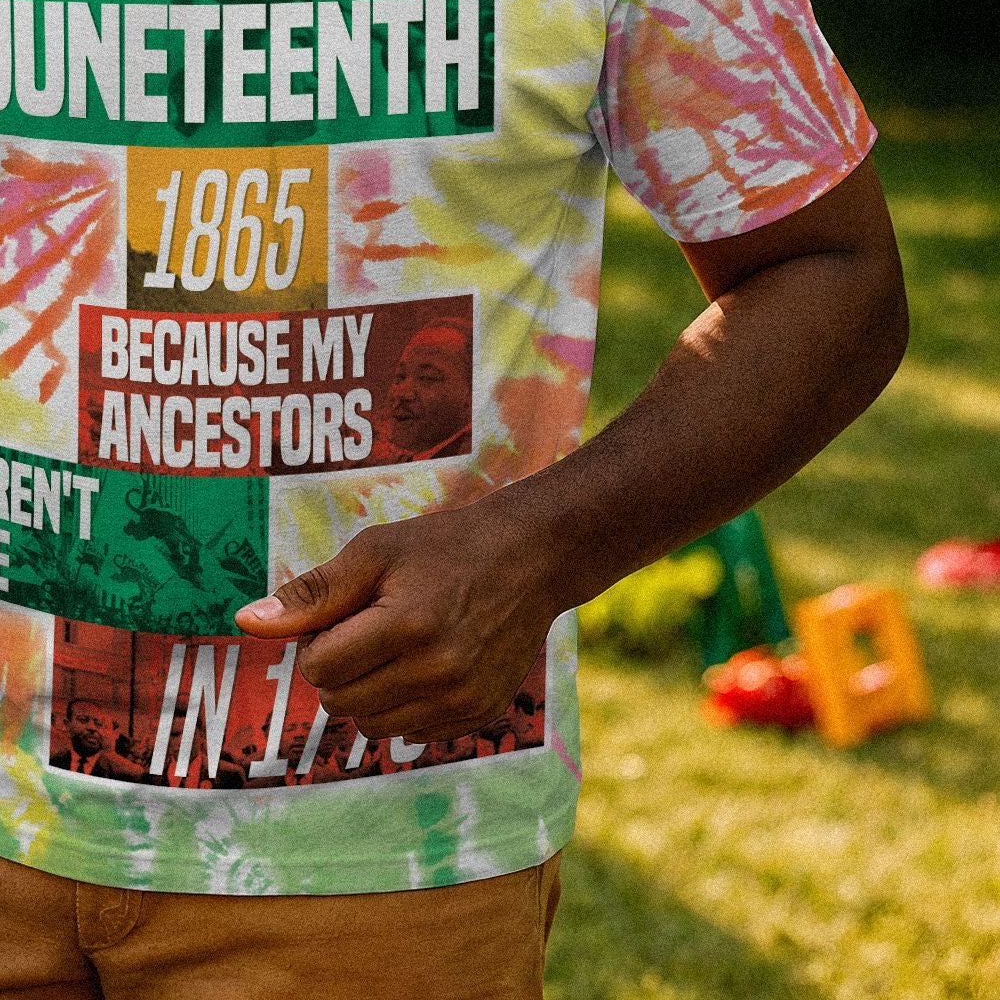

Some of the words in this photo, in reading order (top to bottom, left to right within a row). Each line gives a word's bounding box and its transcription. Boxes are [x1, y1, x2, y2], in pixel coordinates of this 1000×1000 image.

[144, 168, 311, 292] 1865
[101, 315, 290, 387] BECAUSE
[302, 313, 374, 383] MY
[98, 388, 373, 469] ANCESTORS
[149, 643, 240, 779] IN
